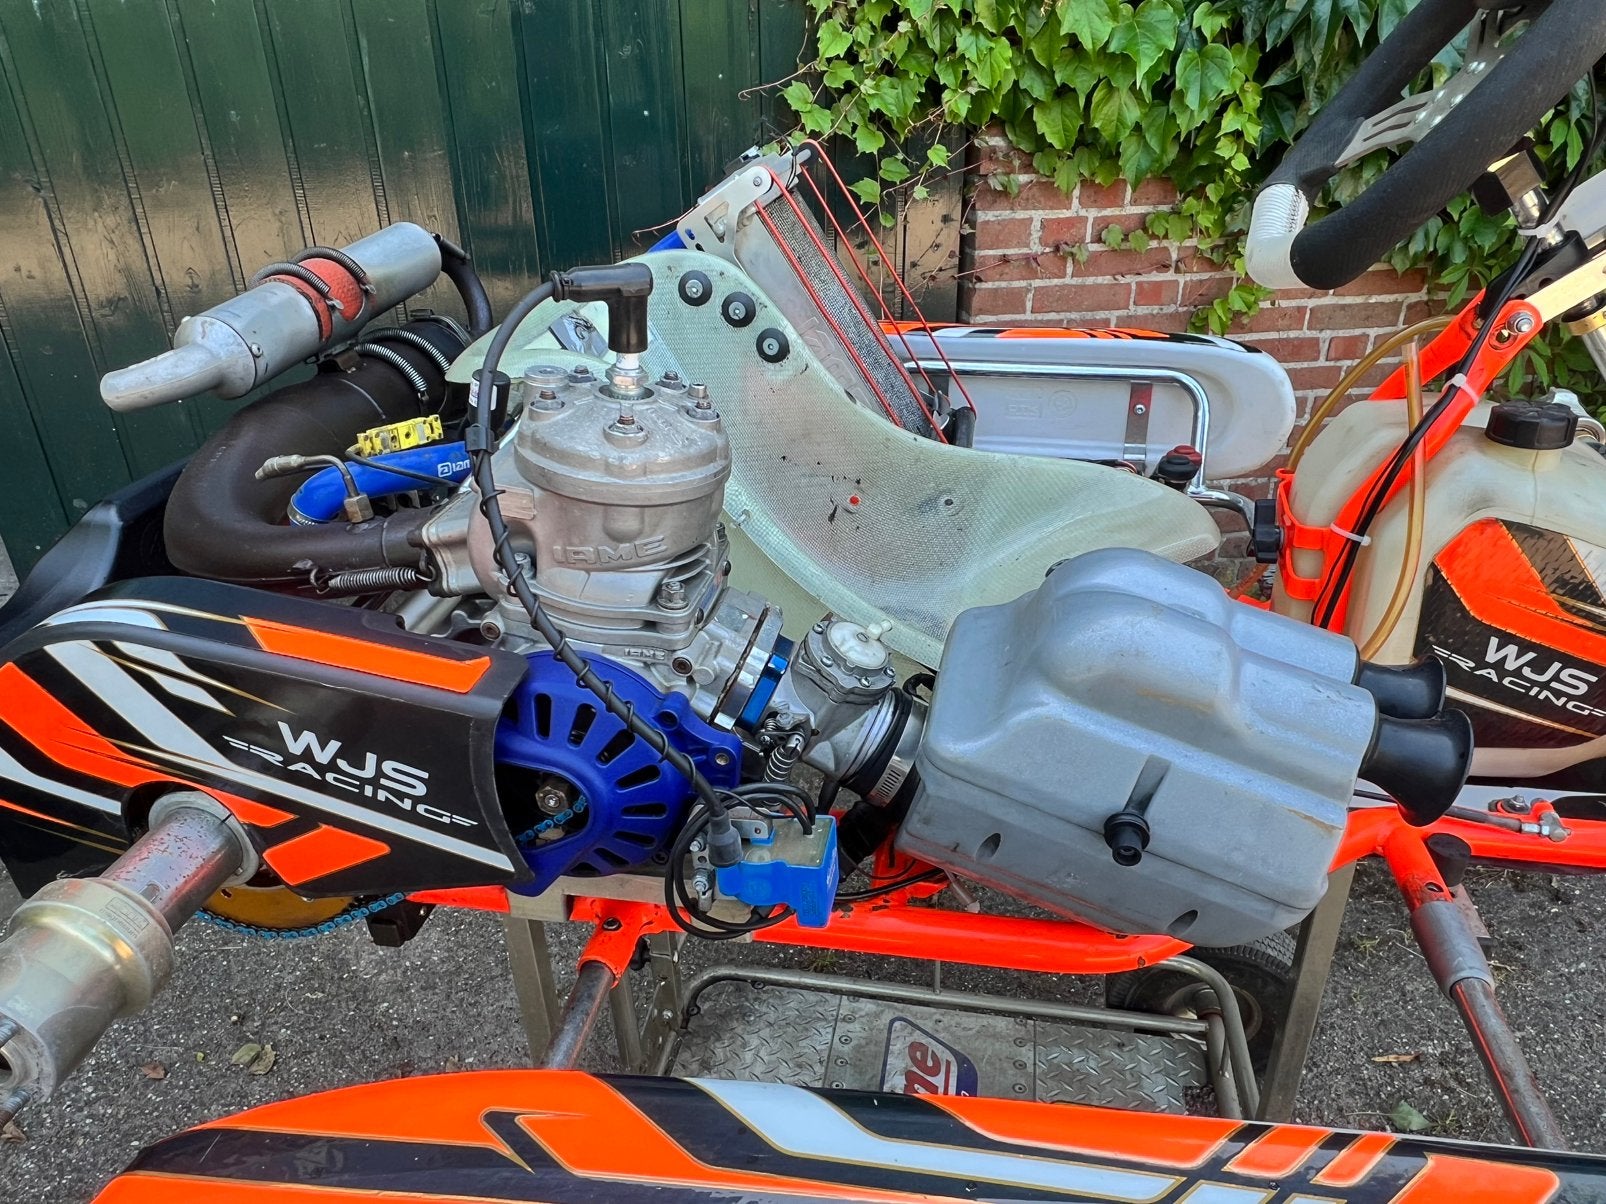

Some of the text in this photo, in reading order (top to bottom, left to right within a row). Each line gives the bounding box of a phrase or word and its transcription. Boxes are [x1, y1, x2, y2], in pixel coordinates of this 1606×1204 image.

[553, 535, 668, 565] IAME
[1440, 648, 1598, 717] RACING
[1485, 636, 1598, 696] WJS
[236, 740, 464, 826] RACING
[277, 721, 429, 797] WJS
